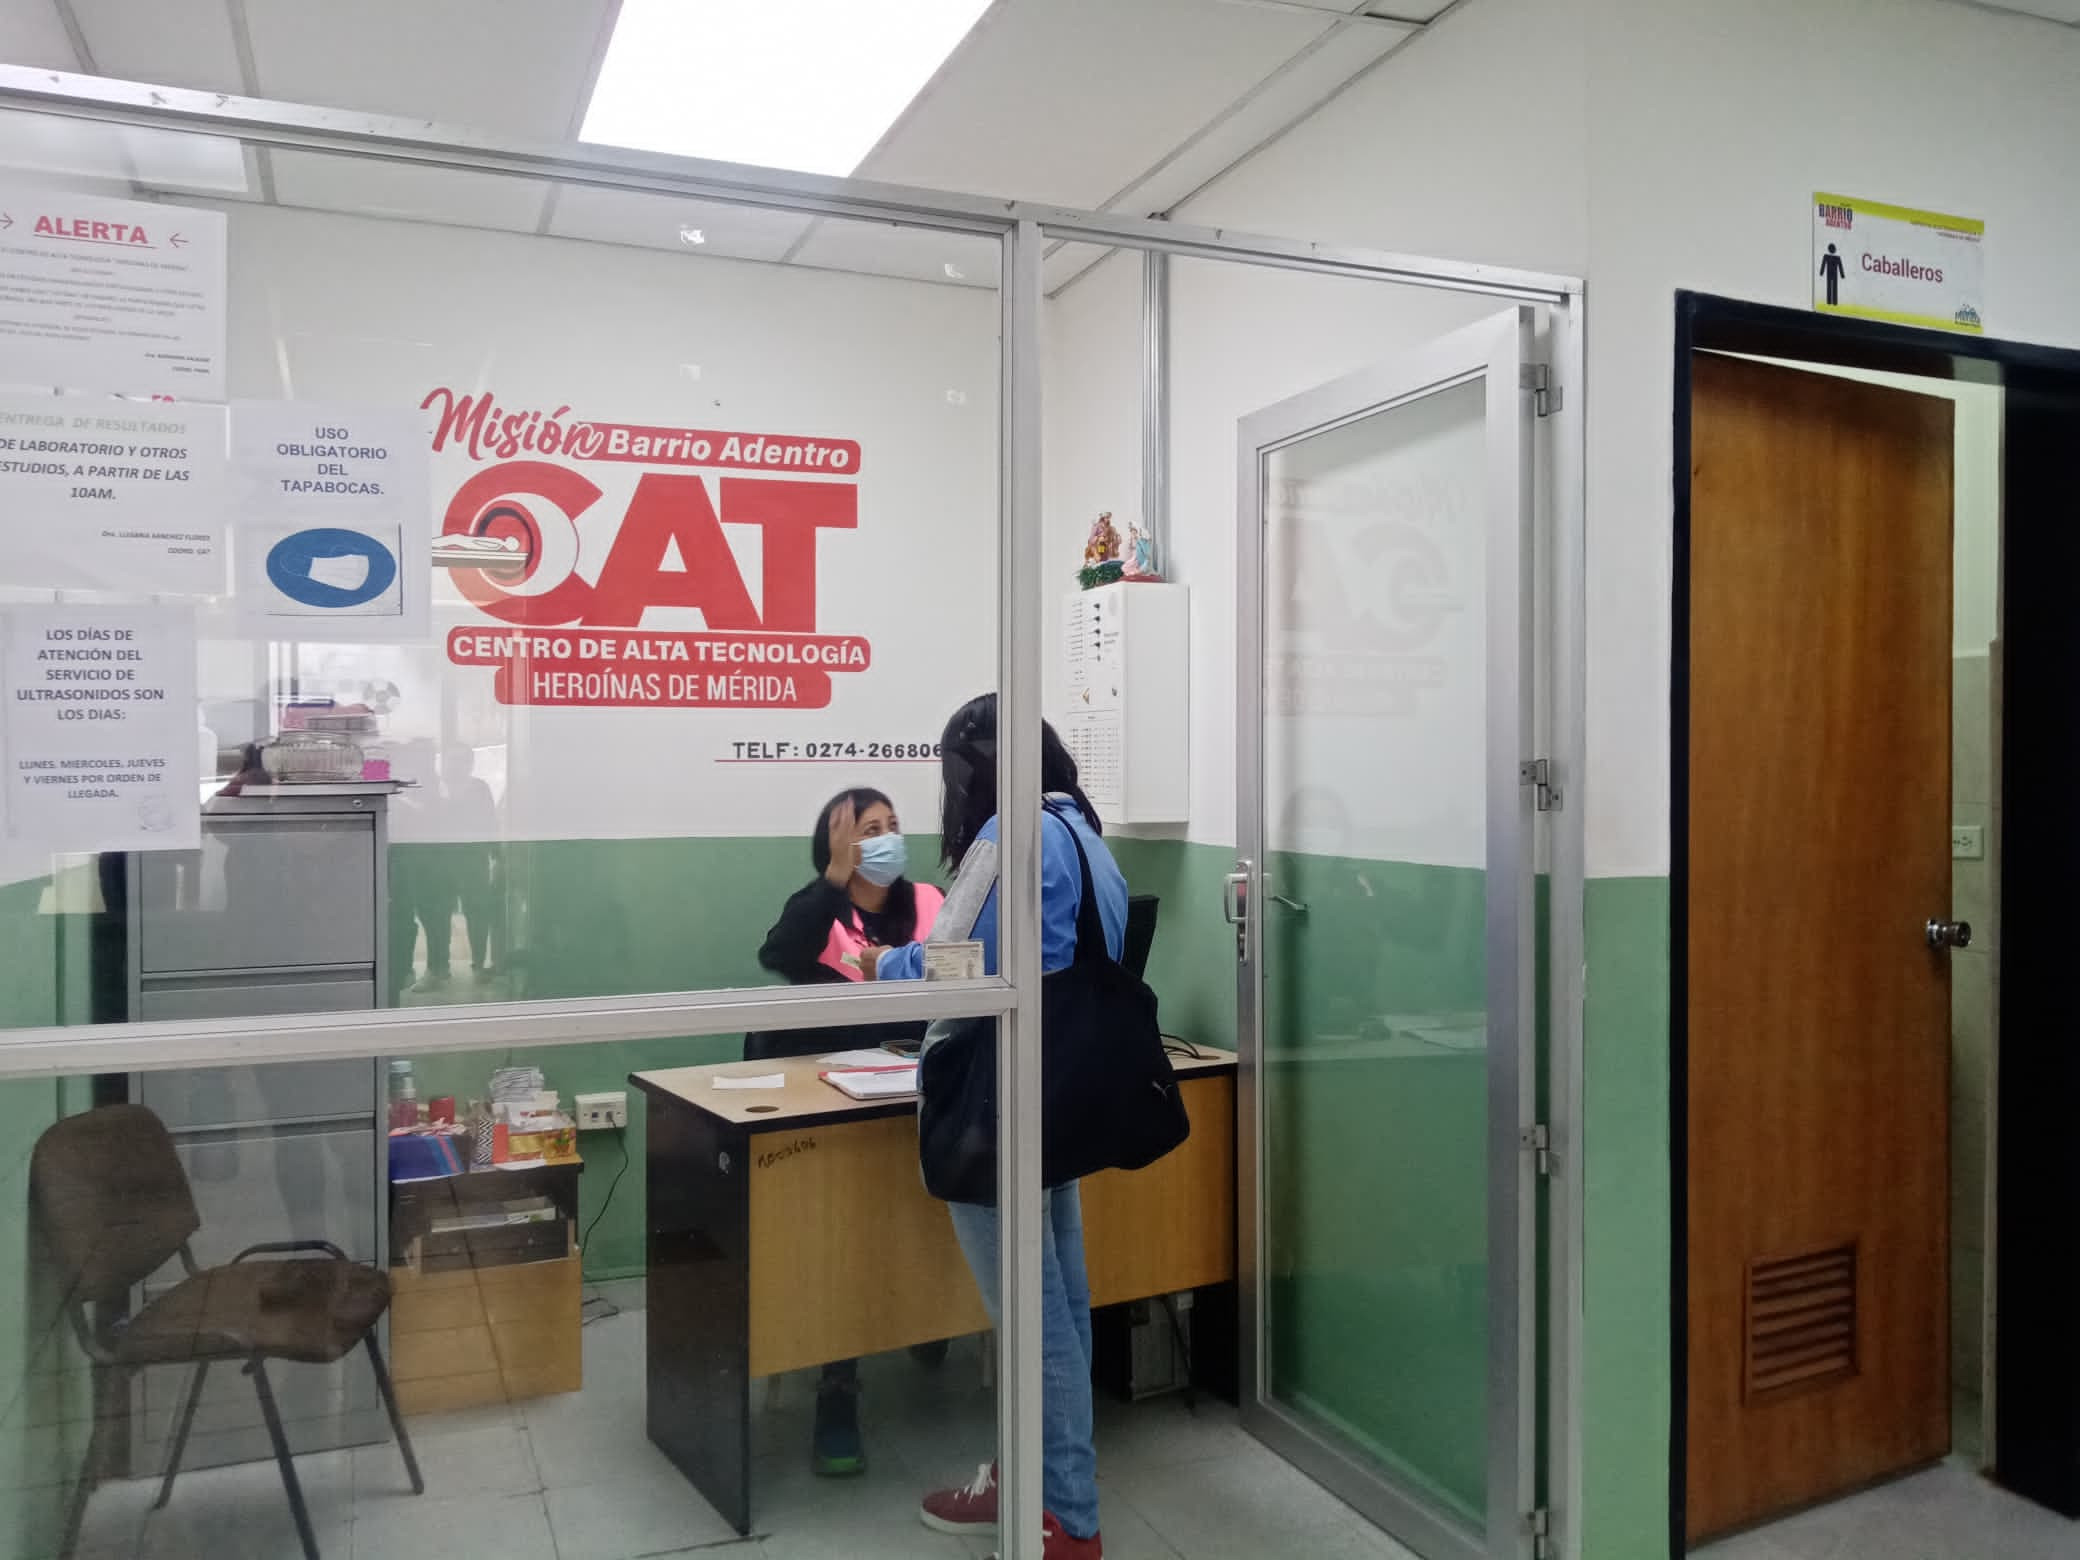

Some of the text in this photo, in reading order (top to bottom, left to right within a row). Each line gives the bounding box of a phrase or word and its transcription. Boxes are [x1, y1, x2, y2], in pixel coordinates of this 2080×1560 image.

[34, 215, 149, 244] ALERTA
[1862, 252, 1944, 284] Caballeros
[72, 416, 92, 429] DE
[420, 387, 849, 468] Misión Barrio Adentro
[315, 427, 349, 440] USO
[19, 439, 124, 456] LABORATORIO
[128, 446, 137, 457] Y
[140, 446, 188, 460] OTROS
[276, 443, 387, 460] OBLIGATORIO
[73, 464, 84, 476] A
[87, 465, 139, 479] PARTIR
[143, 468, 162, 480] DE
[164, 469, 190, 481] LAS
[317, 463, 348, 476] DEL
[71, 486, 116, 500] 10AM.
[281, 479, 384, 495] TAPABOCAS.
[442, 460, 858, 633] CAT
[46, 627, 135, 641] LOS DÍAS DE
[37, 648, 143, 661] ATENCIÓN DEL
[453, 635, 866, 665] CENTRO DE ALTA TECNOLOGÍA
[46, 669, 135, 680] SERVICIO DE
[533, 667, 797, 702] HEROÍNAS DE MÉRIDA
[16, 688, 164, 701] ULTRASONIDOS SON
[57, 709, 84, 720] LOS
[733, 742, 799, 759] TELF:
[127, 758, 166, 768] JUEVES
[24, 773, 161, 784] Y VIERNES POR ORDEN DE
[67, 788, 119, 799] LLEGADA.
